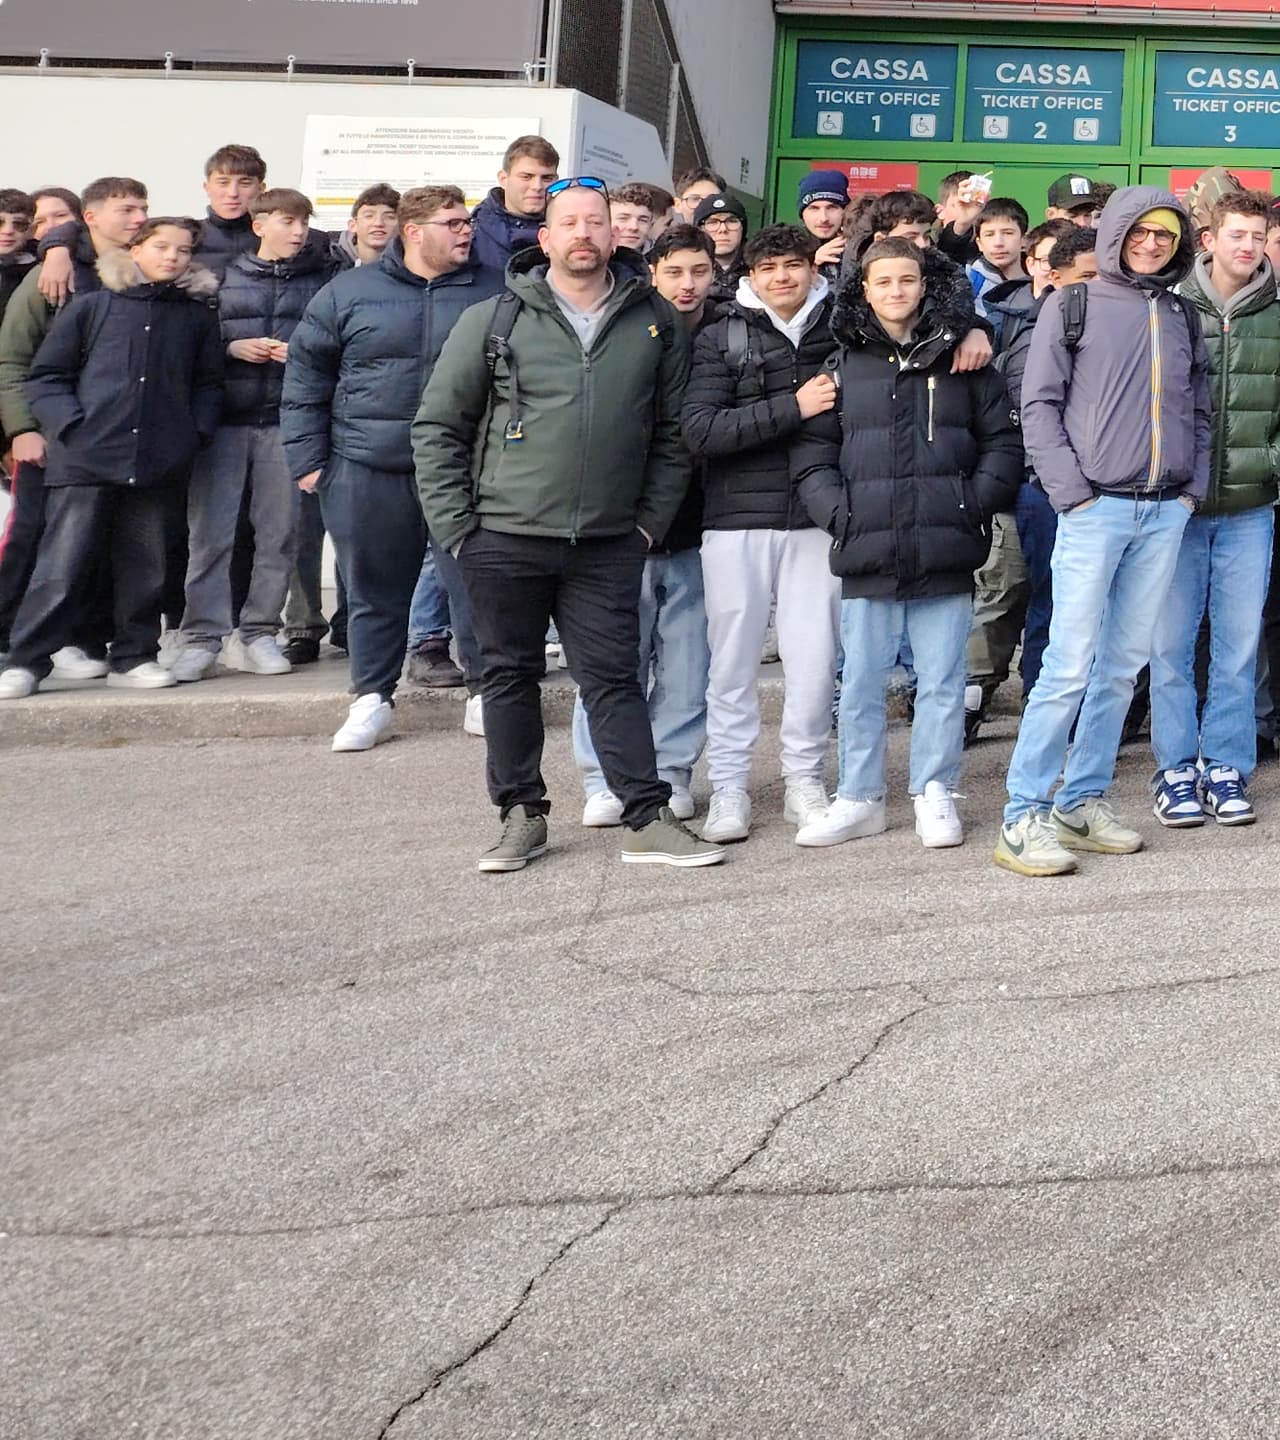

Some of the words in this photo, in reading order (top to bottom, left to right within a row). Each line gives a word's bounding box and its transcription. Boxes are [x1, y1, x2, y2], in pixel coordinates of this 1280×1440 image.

[831, 57, 928, 81] CASSA
[996, 63, 1091, 85] CASSA
[1187, 68, 1279, 89] CASSA
[816, 90, 874, 105] TICKET
[880, 92, 941, 106] OFFICE
[982, 94, 1040, 109] TICKET
[1044, 96, 1103, 110] OFFICE
[1173, 98, 1229, 113] TICKET
[872, 115, 880, 132] 1
[1033, 122, 1047, 139] 2
[1224, 125, 1237, 142] 3
